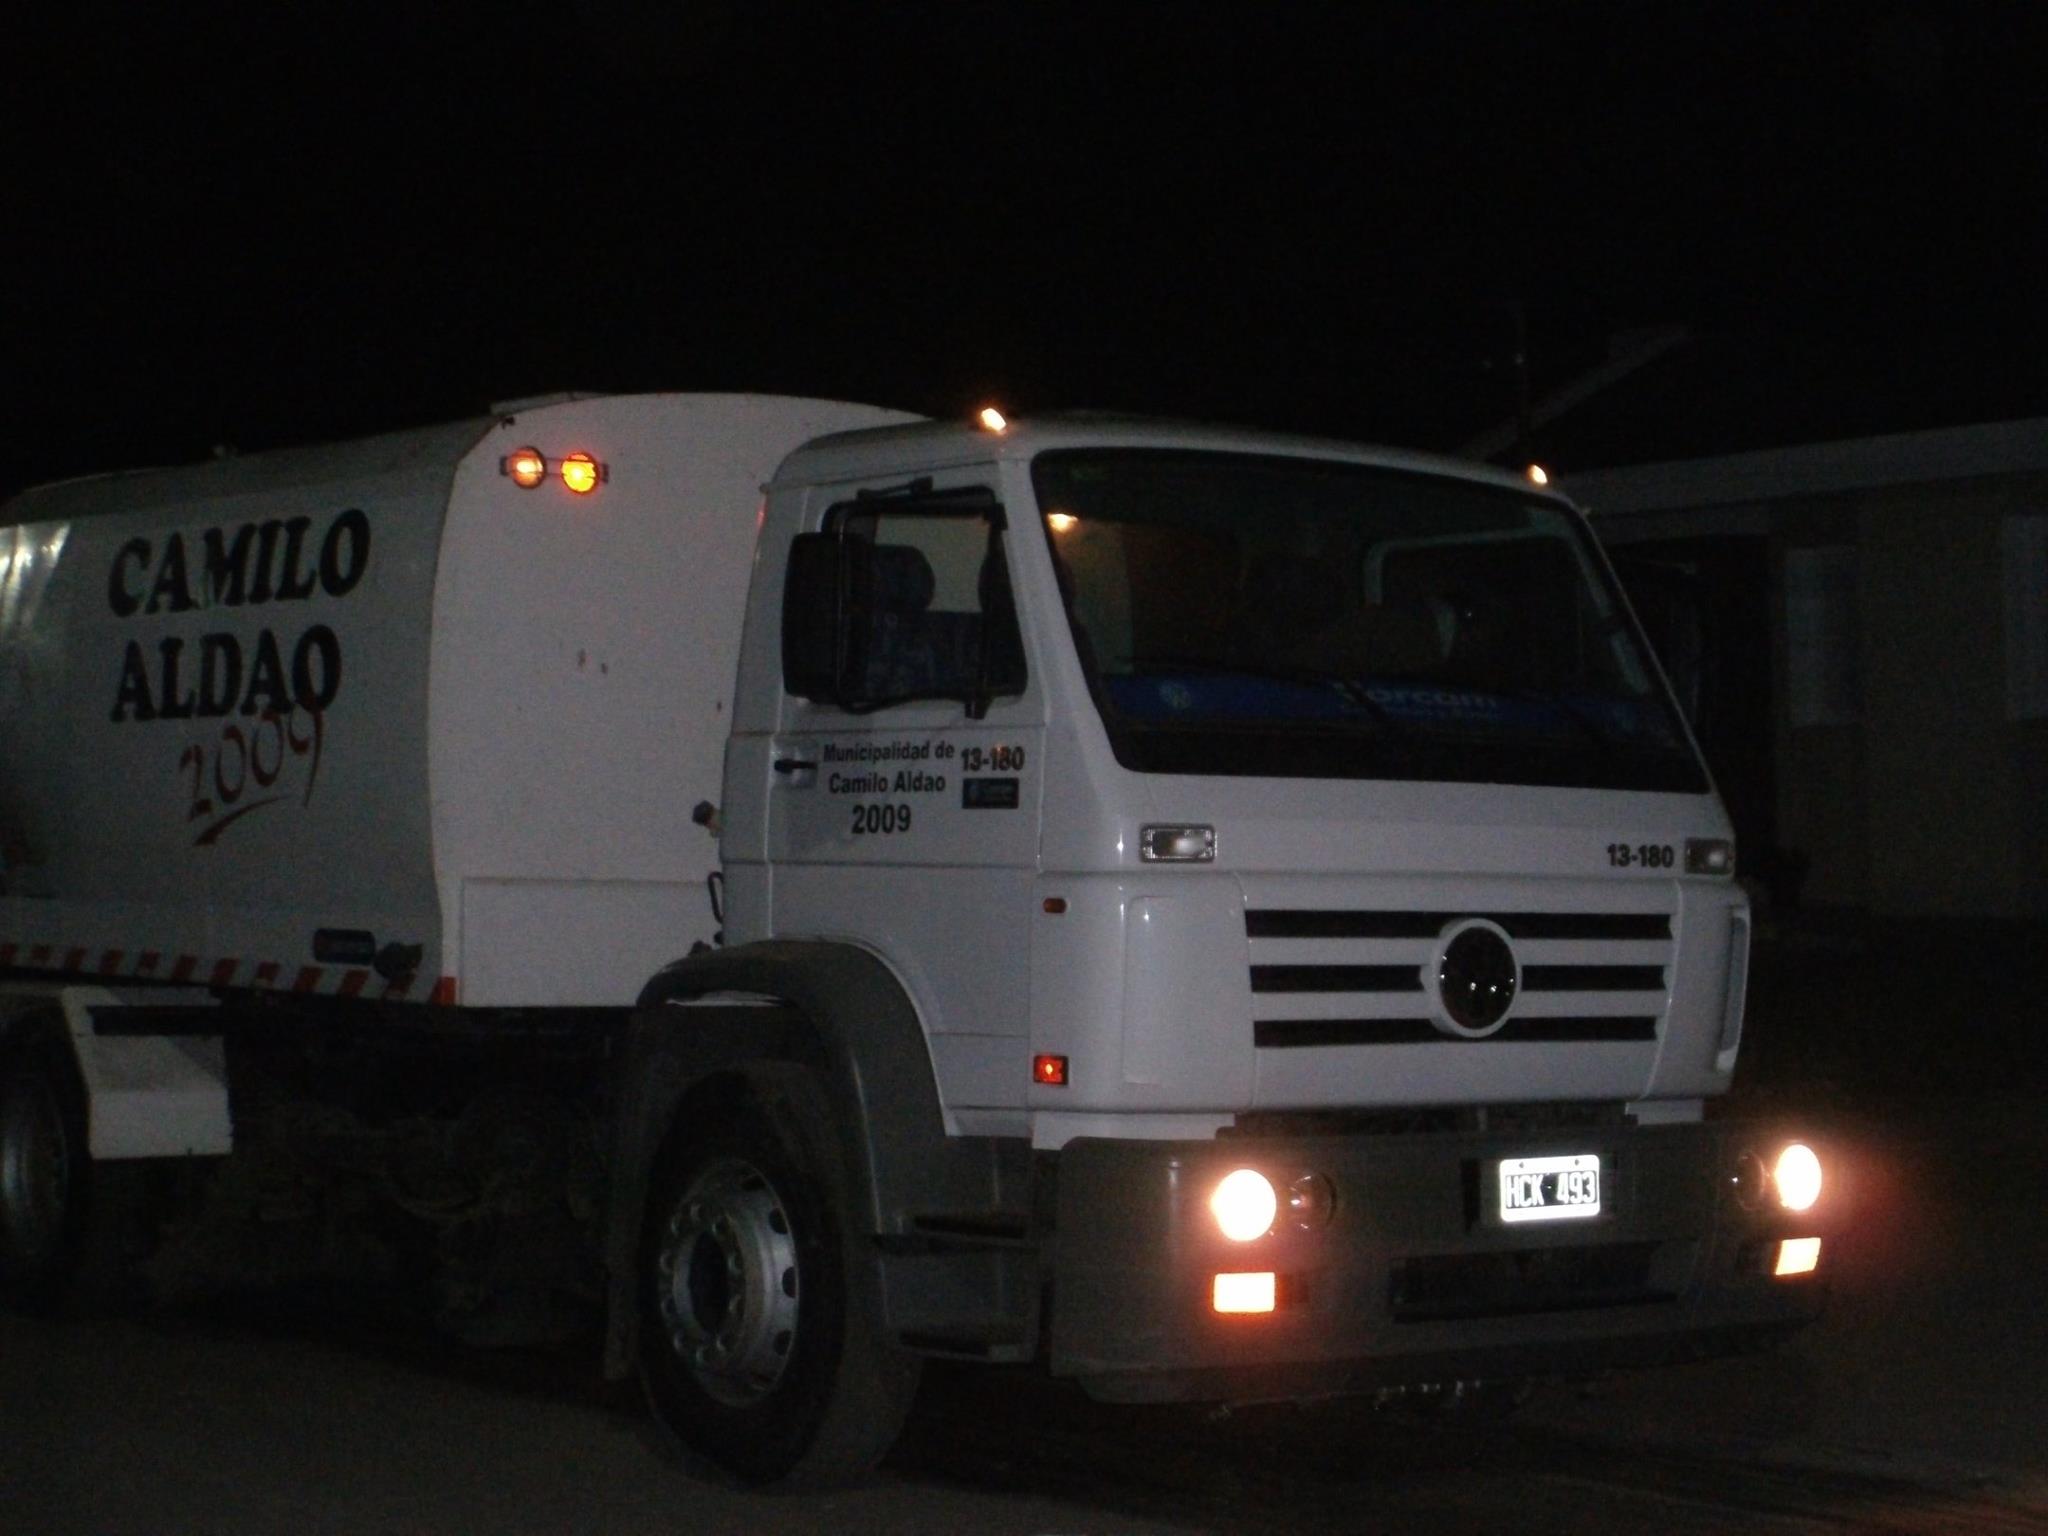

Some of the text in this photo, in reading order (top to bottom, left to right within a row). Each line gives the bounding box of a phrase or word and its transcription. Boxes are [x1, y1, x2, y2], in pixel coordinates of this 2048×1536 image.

[108, 509, 371, 617] CAMILO
[110, 624, 342, 722] ALDAO
[180, 703, 325, 822] 2009
[823, 740, 955, 763] Municipalidad de
[961, 746, 1025, 771] 13-180
[829, 770, 946, 794] Camilo Aldao
[852, 804, 911, 834] 2009
[1607, 844, 1674, 868] 13-180
[1506, 1170, 1597, 1208] HCK 493
